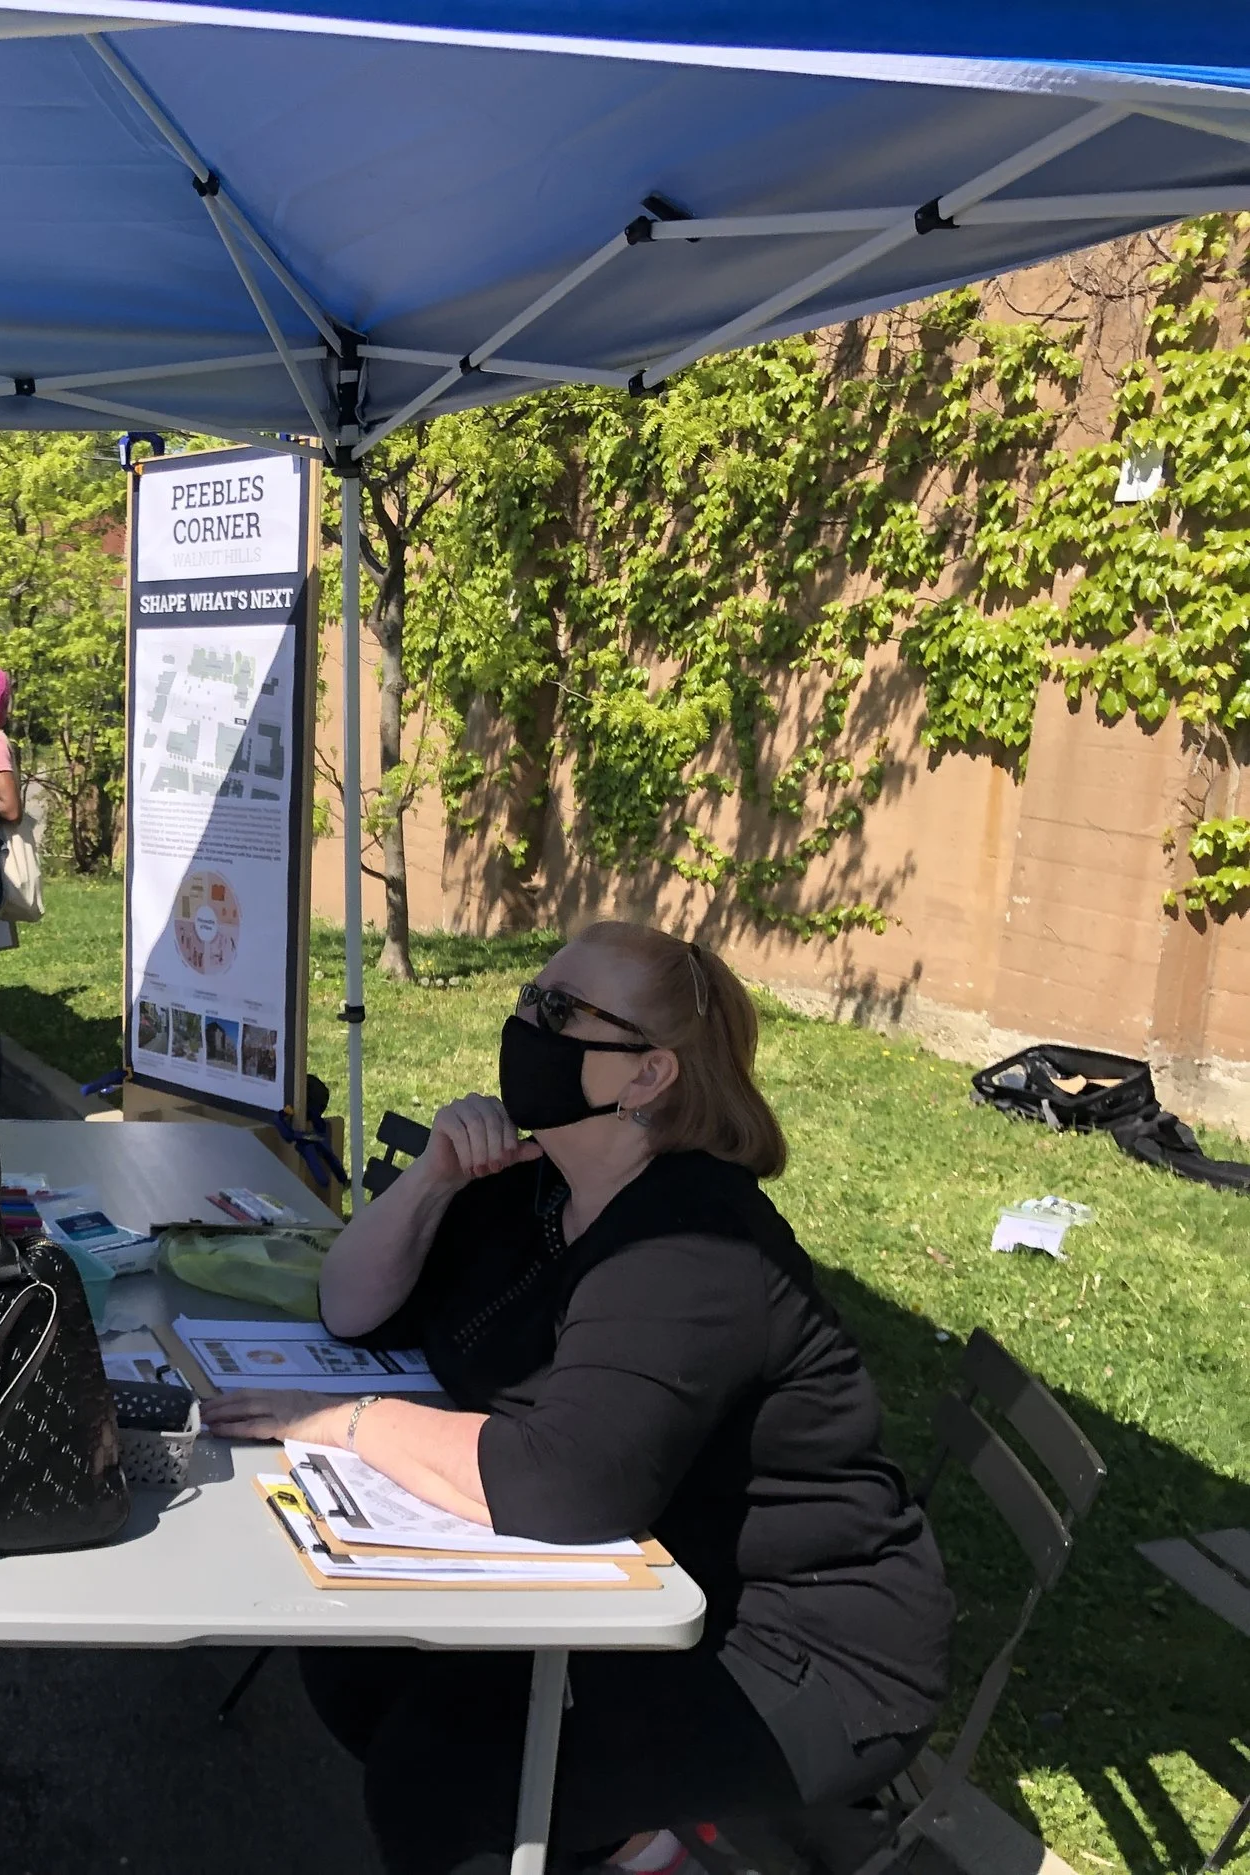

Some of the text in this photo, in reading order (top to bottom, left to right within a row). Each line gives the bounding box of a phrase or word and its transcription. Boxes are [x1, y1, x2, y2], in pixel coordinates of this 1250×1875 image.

[171, 474, 264, 511] PEEBLES
[173, 511, 262, 544] CORNER
[172, 546, 262, 568] WALNUT HILLS
[139, 587, 294, 614] SHAPE WHAT'S NEXT
